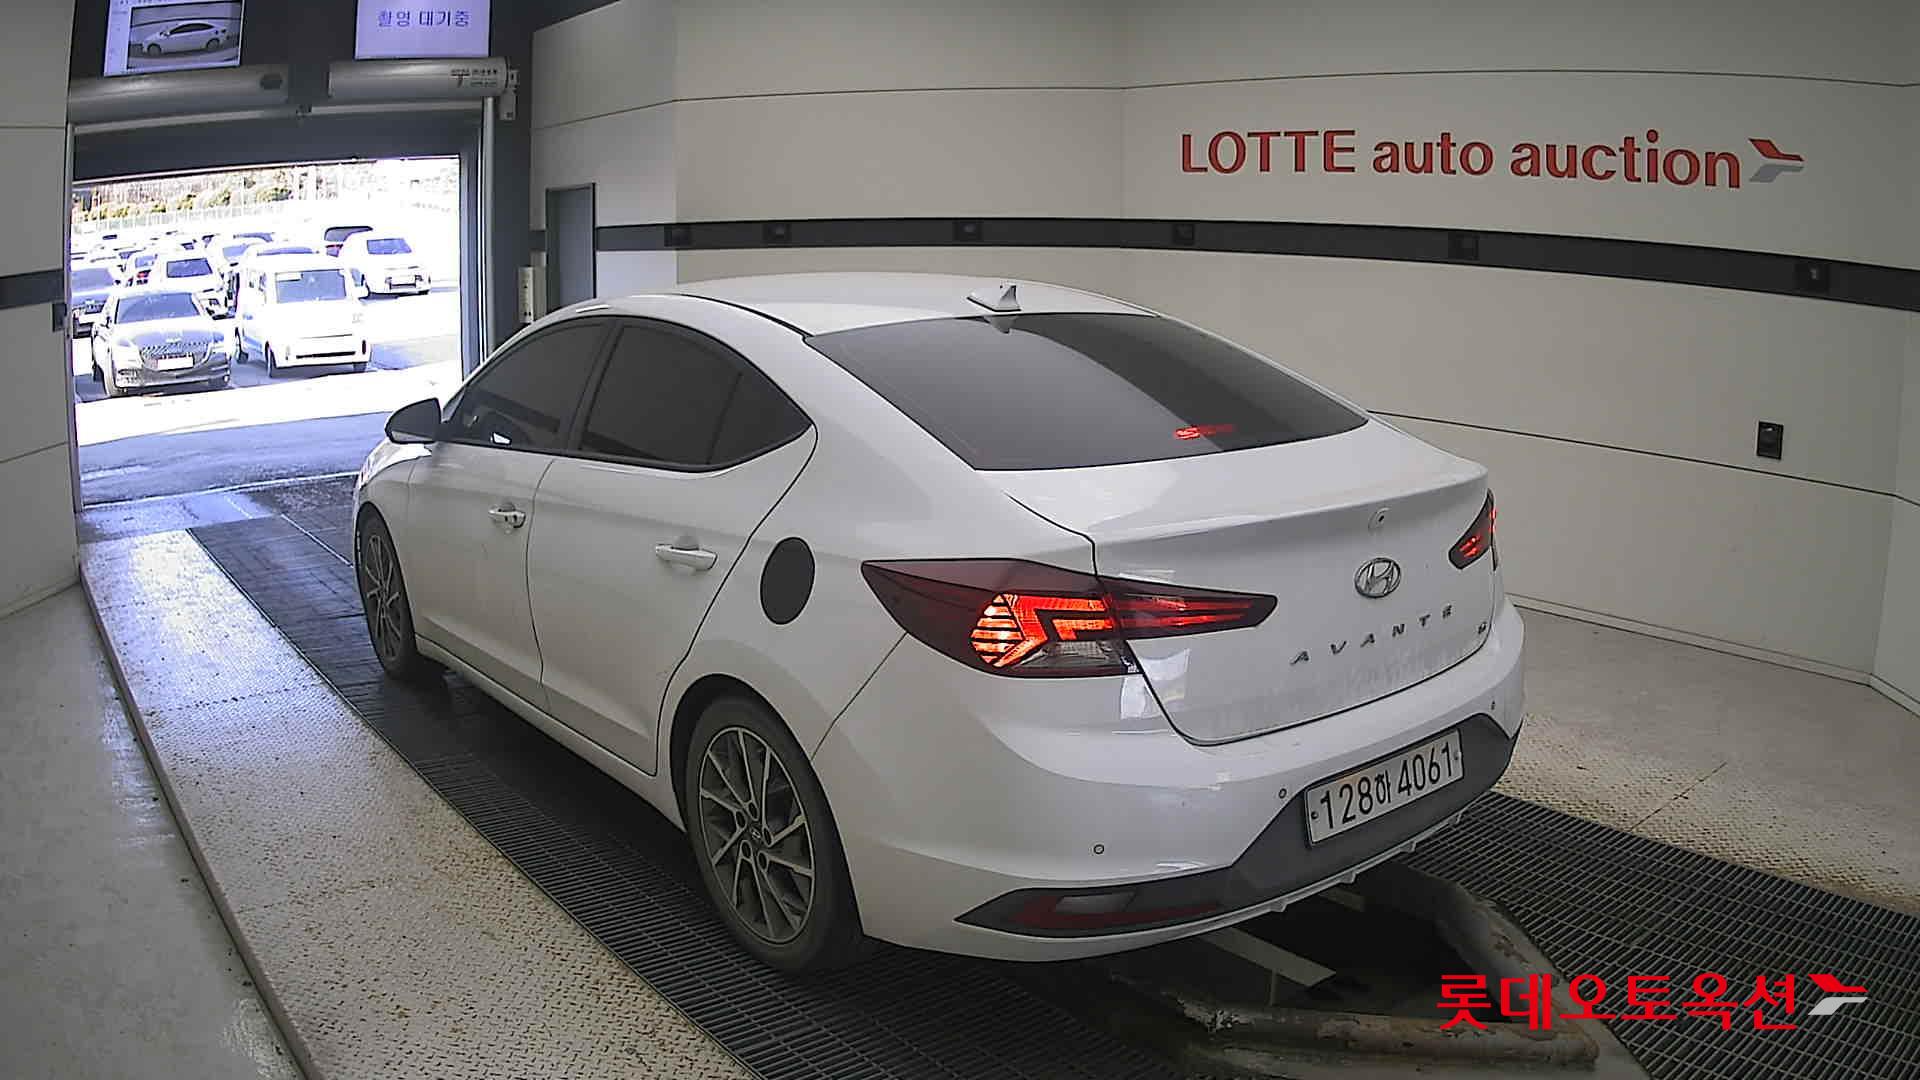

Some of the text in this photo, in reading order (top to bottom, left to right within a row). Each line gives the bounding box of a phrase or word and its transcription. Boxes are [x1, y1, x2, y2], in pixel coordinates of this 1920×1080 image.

[419, 10, 472, 28] 대기중
[1180, 129, 1742, 189] LOTTE auto auction
[1290, 604, 1453, 666] AVANTE
[1320, 741, 1452, 830] 128하 4061
